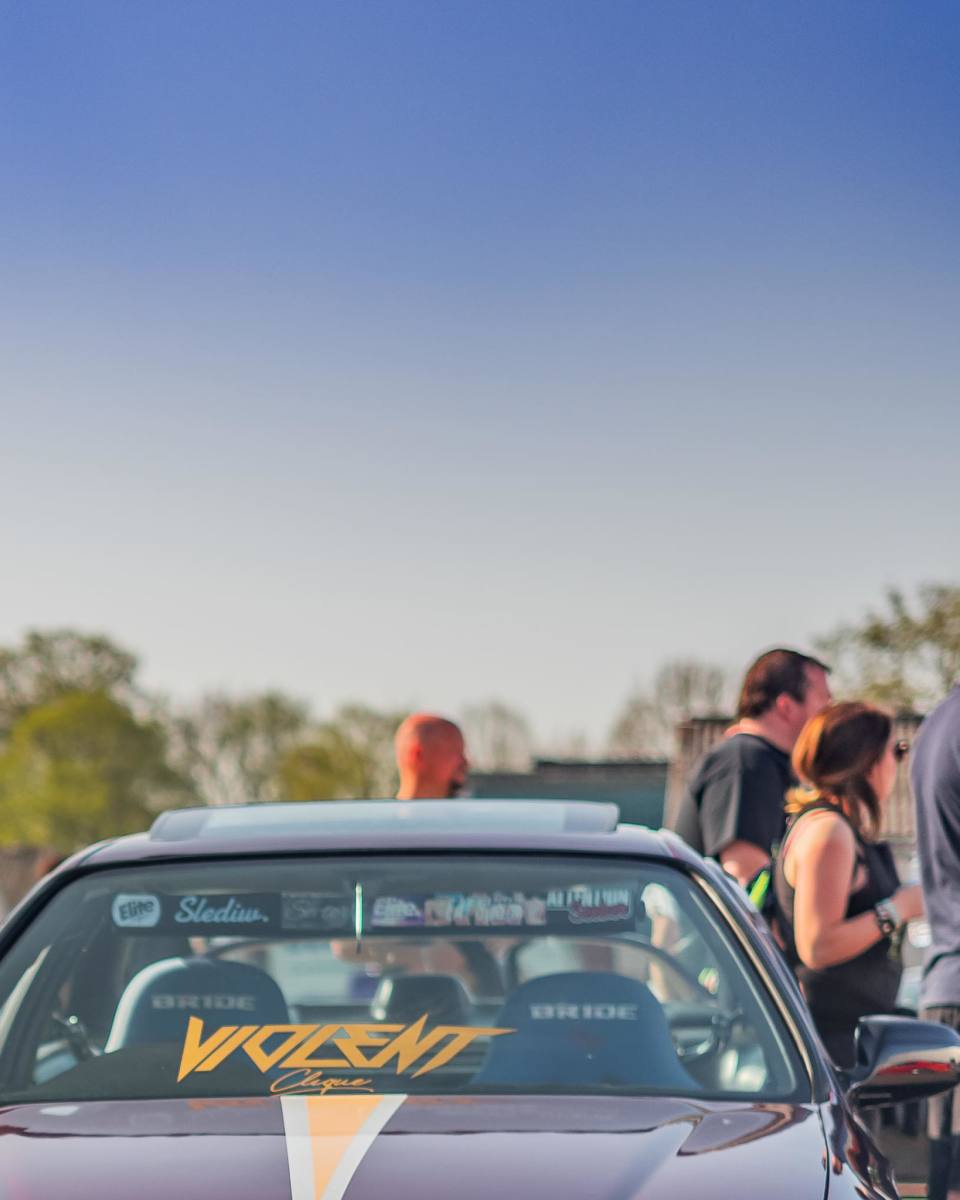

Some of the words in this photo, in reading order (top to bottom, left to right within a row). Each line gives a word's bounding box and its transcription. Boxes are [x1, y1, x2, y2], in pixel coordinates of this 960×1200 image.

[119, 901, 155, 921] Elite
[152, 995, 256, 1011] BRIDE
[530, 1004, 638, 1020] BRIDE
[176, 1012, 517, 1083] VIOLENT
